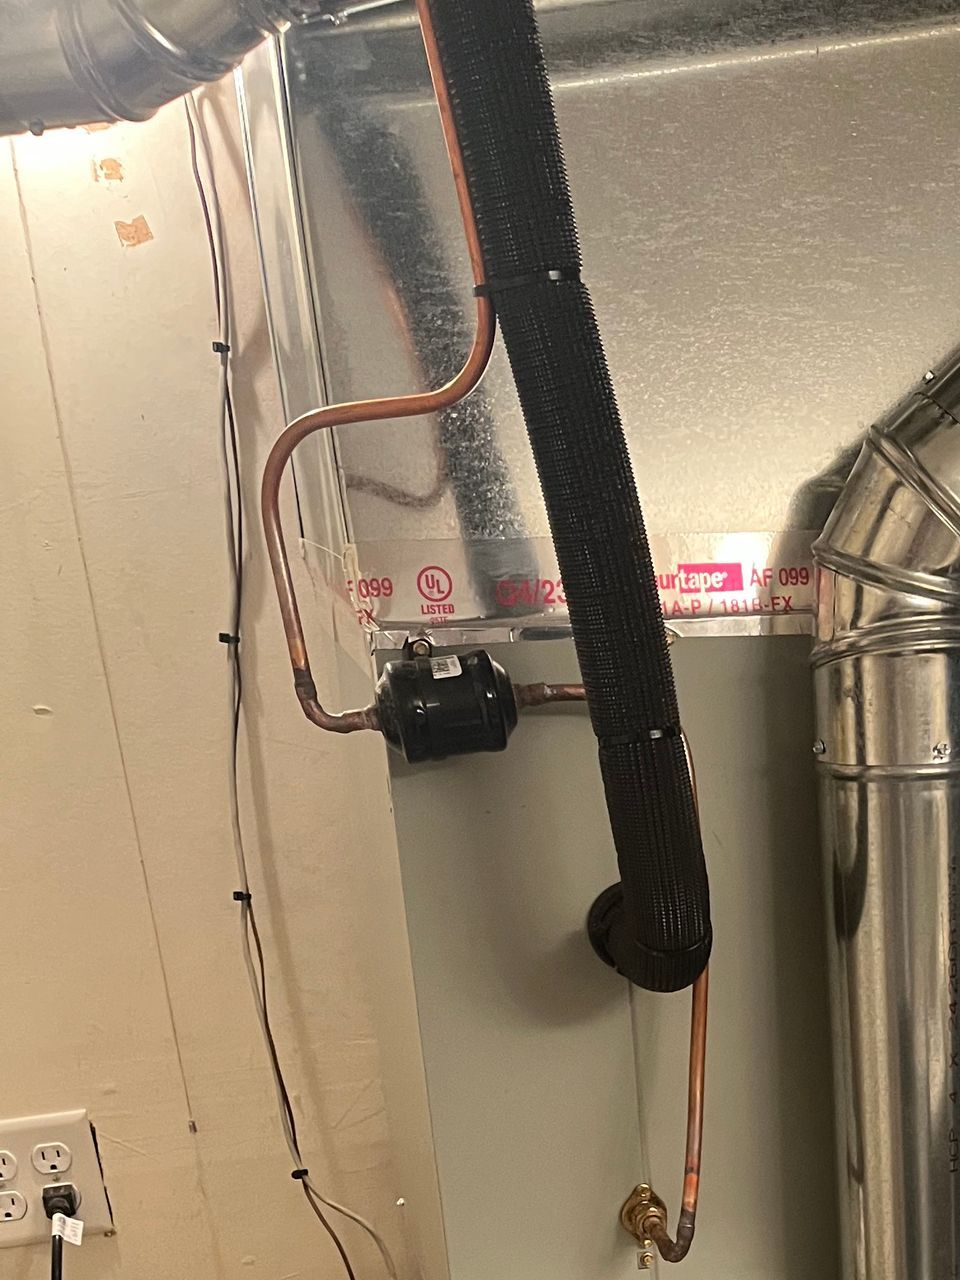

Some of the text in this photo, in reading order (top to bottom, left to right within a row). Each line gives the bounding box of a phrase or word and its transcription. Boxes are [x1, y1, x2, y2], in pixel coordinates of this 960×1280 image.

[357, 576, 394, 599] 099
[655, 569, 728, 592] urtape
[750, 568, 810, 588] AF 099
[421, 603, 455, 616] LISTED
[662, 598, 701, 616] 1A-P
[721, 596, 794, 614] 181B-FX
[948, 1128, 959, 1174] HCP
